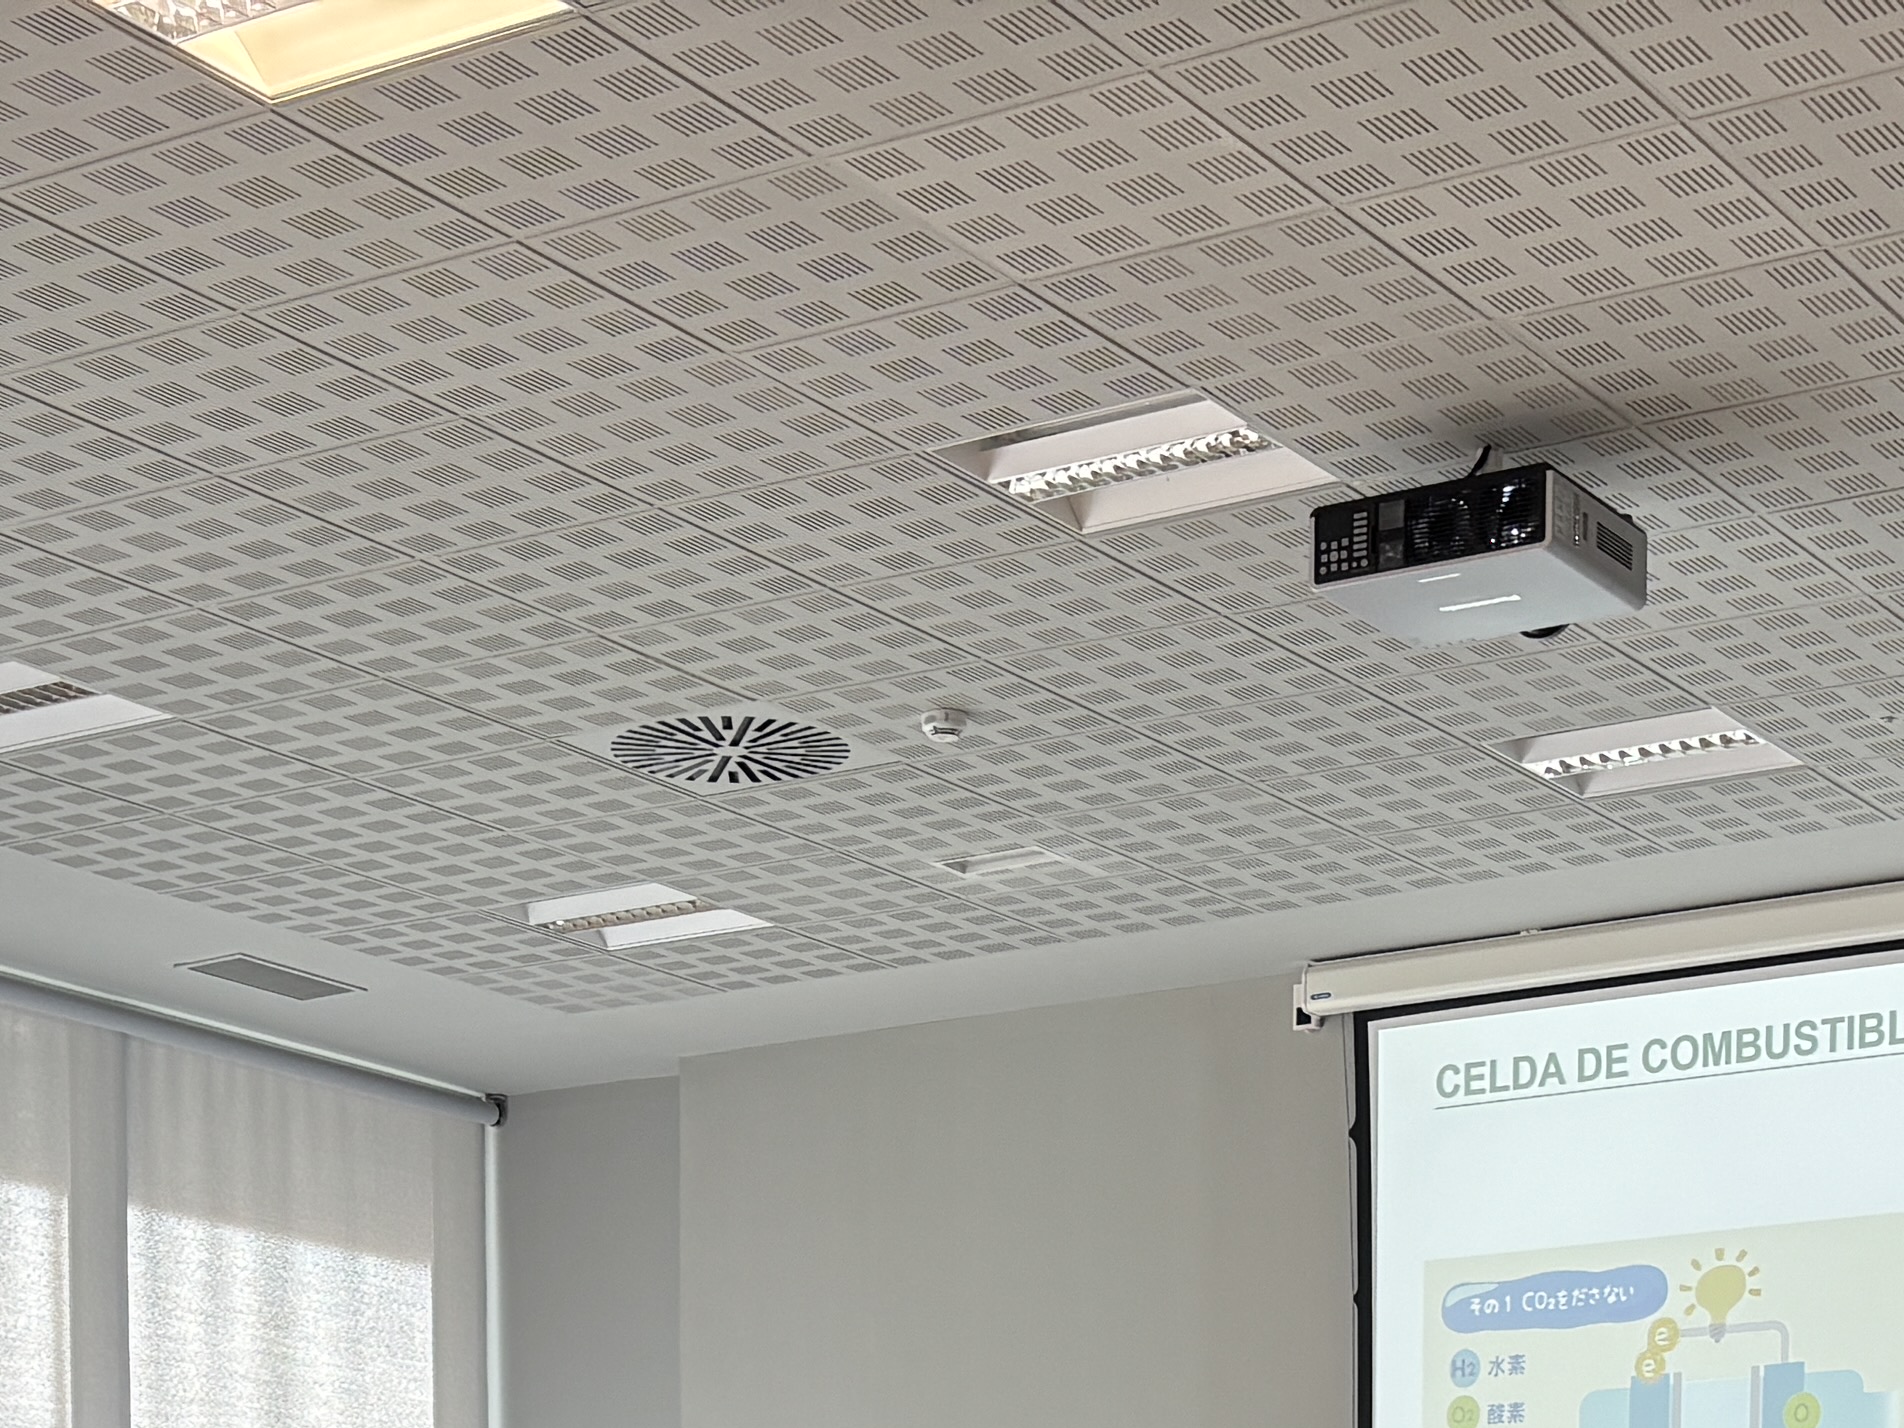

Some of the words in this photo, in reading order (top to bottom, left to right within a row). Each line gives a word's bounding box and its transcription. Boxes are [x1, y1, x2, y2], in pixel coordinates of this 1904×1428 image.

[1436, 1054, 1566, 1100] CELDA
[1577, 1043, 1630, 1080] DE
[1487, 1354, 1526, 1377] 水素
[1487, 1402, 1526, 1425] 酸素
